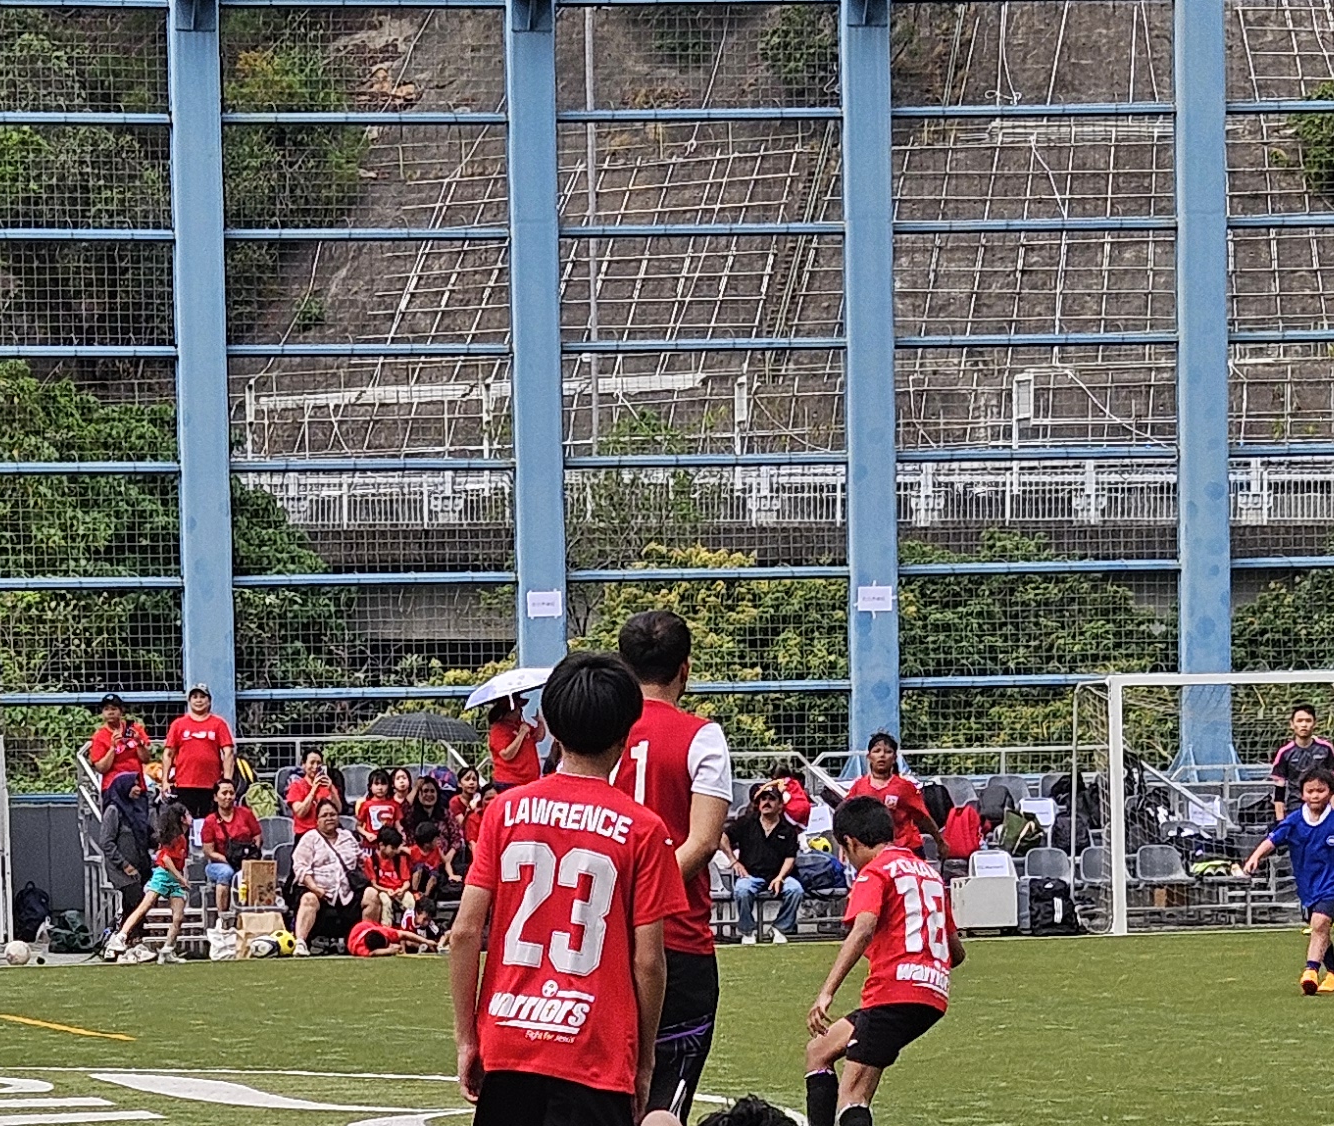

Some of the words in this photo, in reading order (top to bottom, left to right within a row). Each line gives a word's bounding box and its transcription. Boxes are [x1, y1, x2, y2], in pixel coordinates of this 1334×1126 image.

[504, 797, 633, 845] LAWRENCE
[500, 841, 617, 976] 23
[894, 875, 950, 963] 18
[488, 992, 590, 1027] warriors
